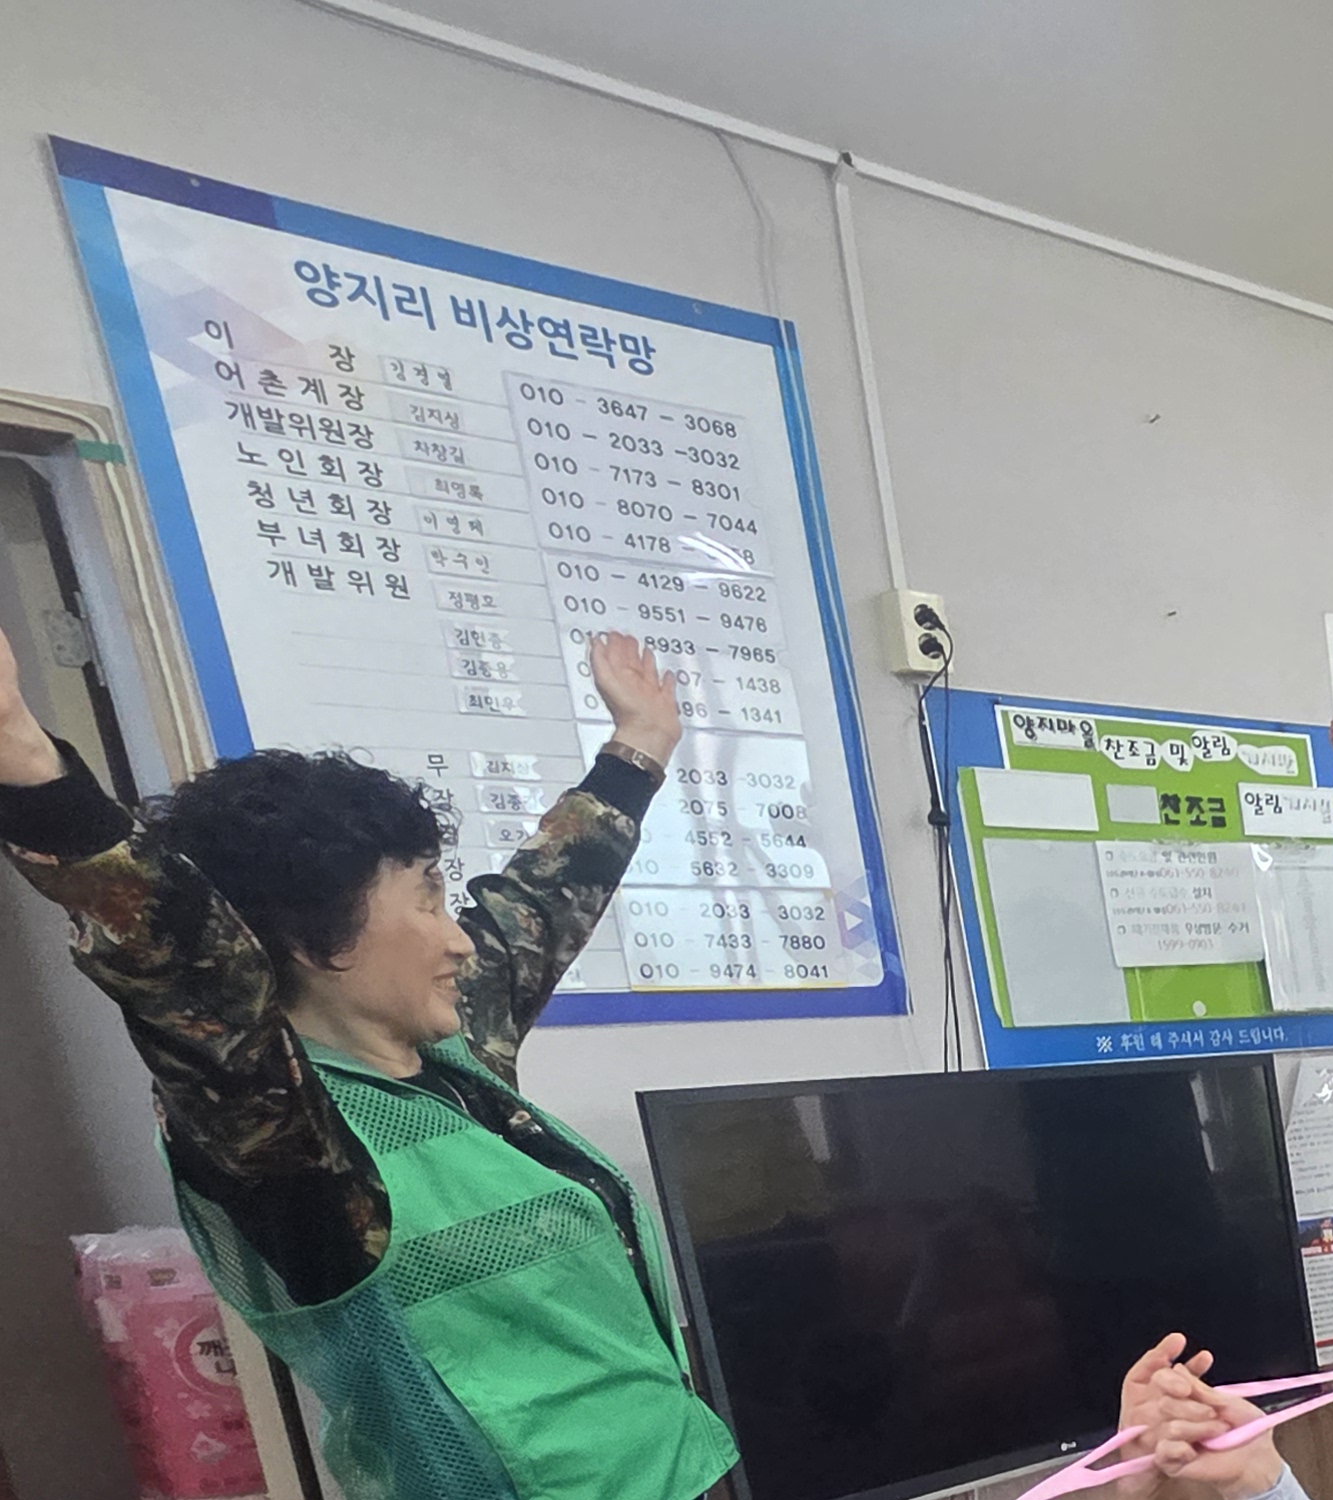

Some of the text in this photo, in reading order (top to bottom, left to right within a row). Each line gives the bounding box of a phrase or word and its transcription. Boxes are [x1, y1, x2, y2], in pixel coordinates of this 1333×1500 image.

[294, 260, 657, 376] 양지리 비상연락망
[520, 383, 564, 406] 010
[597, 397, 648, 421] 3647
[684, 414, 737, 439] 3068
[224, 401, 374, 450] 개발위원장
[534, 452, 578, 475] 010
[610, 465, 657, 488] 7173
[691, 479, 740, 501] 8301
[527, 418, 571, 440] 010
[609, 432, 663, 457] 2033
[542, 488, 584, 509] 010
[617, 499, 672, 522] 8070
[706, 513, 758, 535] 7044
[549, 522, 591, 543] 010
[624, 533, 671, 554] 4178
[557, 561, 600, 582] 010
[637, 573, 684, 592] 4129
[718, 582, 767, 603] 9622
[564, 595, 606, 615] 010
[637, 603, 686, 624] 9551
[645, 635, 696, 655] 8933
[728, 644, 776, 664] 7965
[736, 676, 781, 694] 1438
[741, 707, 782, 724] 1341
[1012, 713, 1095, 749] 양지마을
[1104, 735, 1158, 767] 찬조금
[1169, 742, 1188, 766] 및
[1191, 735, 1231, 757] 알림
[676, 768, 728, 786] 2033
[680, 799, 728, 816] 2075
[756, 802, 808, 820] 7008
[1160, 793, 1226, 828] 찬조금
[1244, 792, 1283, 815] 알림
[685, 831, 733, 847] 4552
[761, 833, 807, 848] 5644
[690, 860, 739, 877] 5632
[766, 863, 814, 879] 3309
[629, 901, 668, 917] 010
[700, 902, 750, 920] 2033
[777, 905, 825, 921] 3032
[634, 932, 674, 948] 010
[704, 934, 752, 949] 7433
[779, 935, 825, 950] 7880
[639, 963, 679, 979] 010
[710, 963, 757, 979] 9474
[784, 963, 829, 979] 8041
